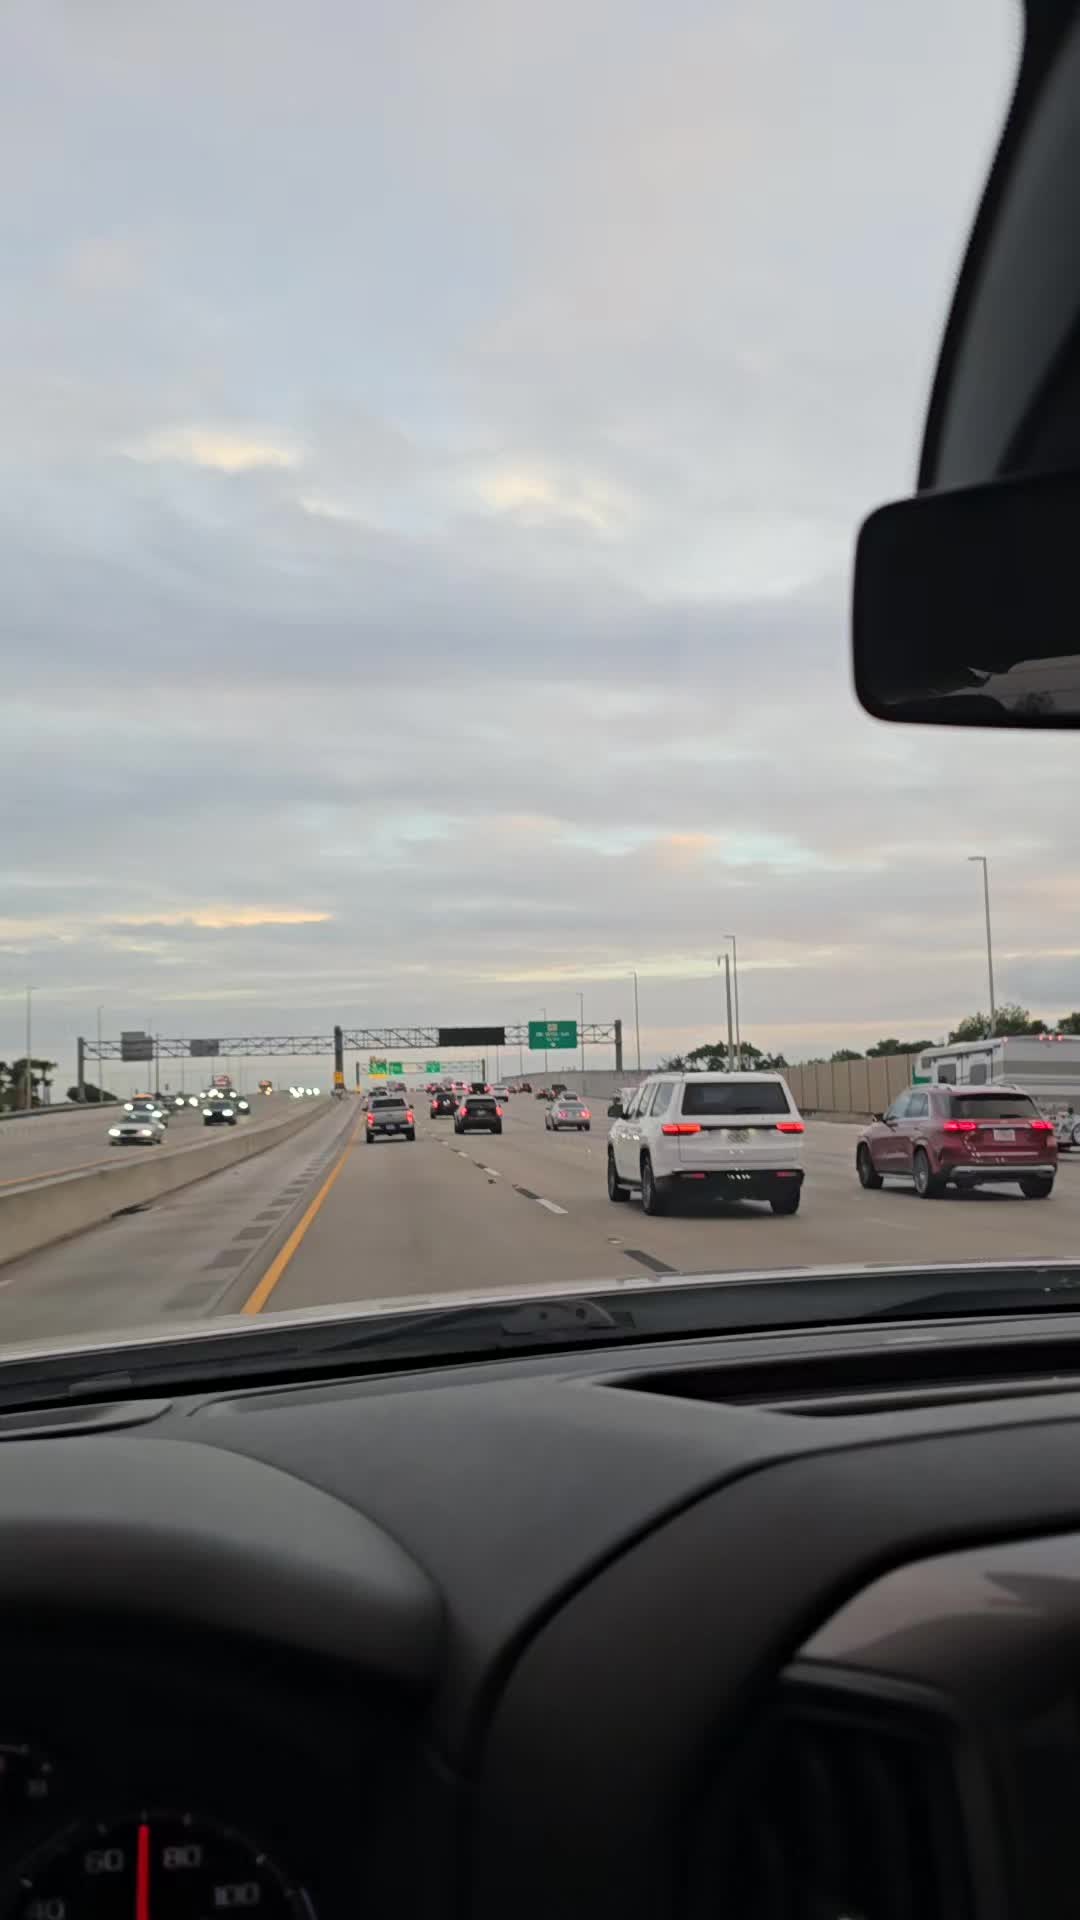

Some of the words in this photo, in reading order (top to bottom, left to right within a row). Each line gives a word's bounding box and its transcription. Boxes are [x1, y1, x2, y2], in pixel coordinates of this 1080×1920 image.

[85, 1848, 124, 1872] 60
[163, 1846, 202, 1869] 80
[214, 1882, 260, 1906] 100
